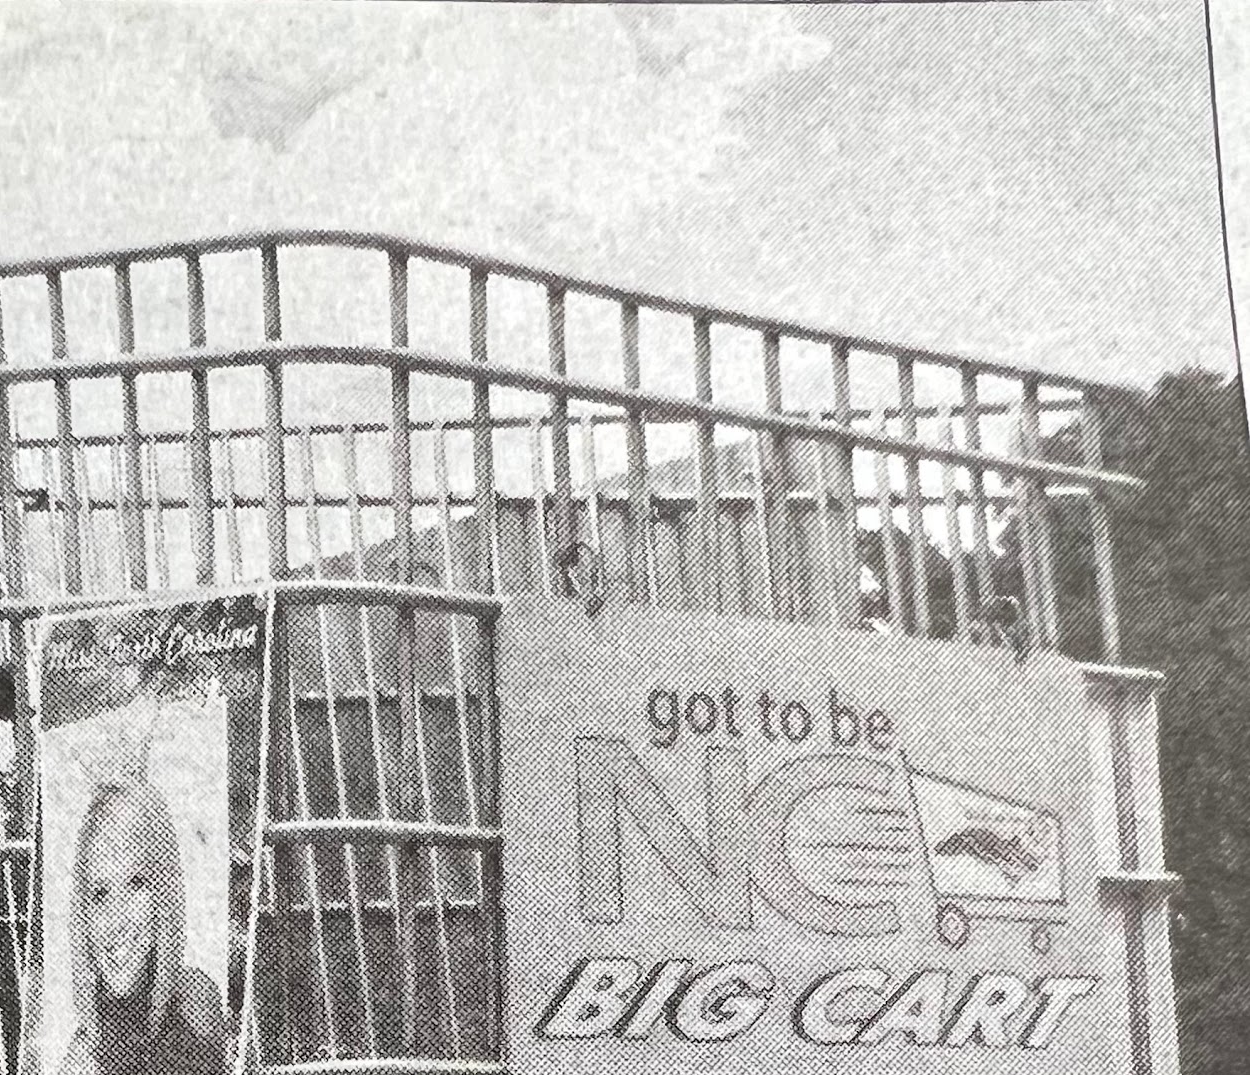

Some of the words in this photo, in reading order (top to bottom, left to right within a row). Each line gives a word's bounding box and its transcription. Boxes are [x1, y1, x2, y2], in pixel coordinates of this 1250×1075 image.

[165, 616, 258, 665] Carolina
[649, 686, 742, 749] got
[757, 690, 816, 744] to
[830, 686, 893, 750] be
[533, 955, 777, 1045] BIG
[789, 964, 1101, 1051] CART
